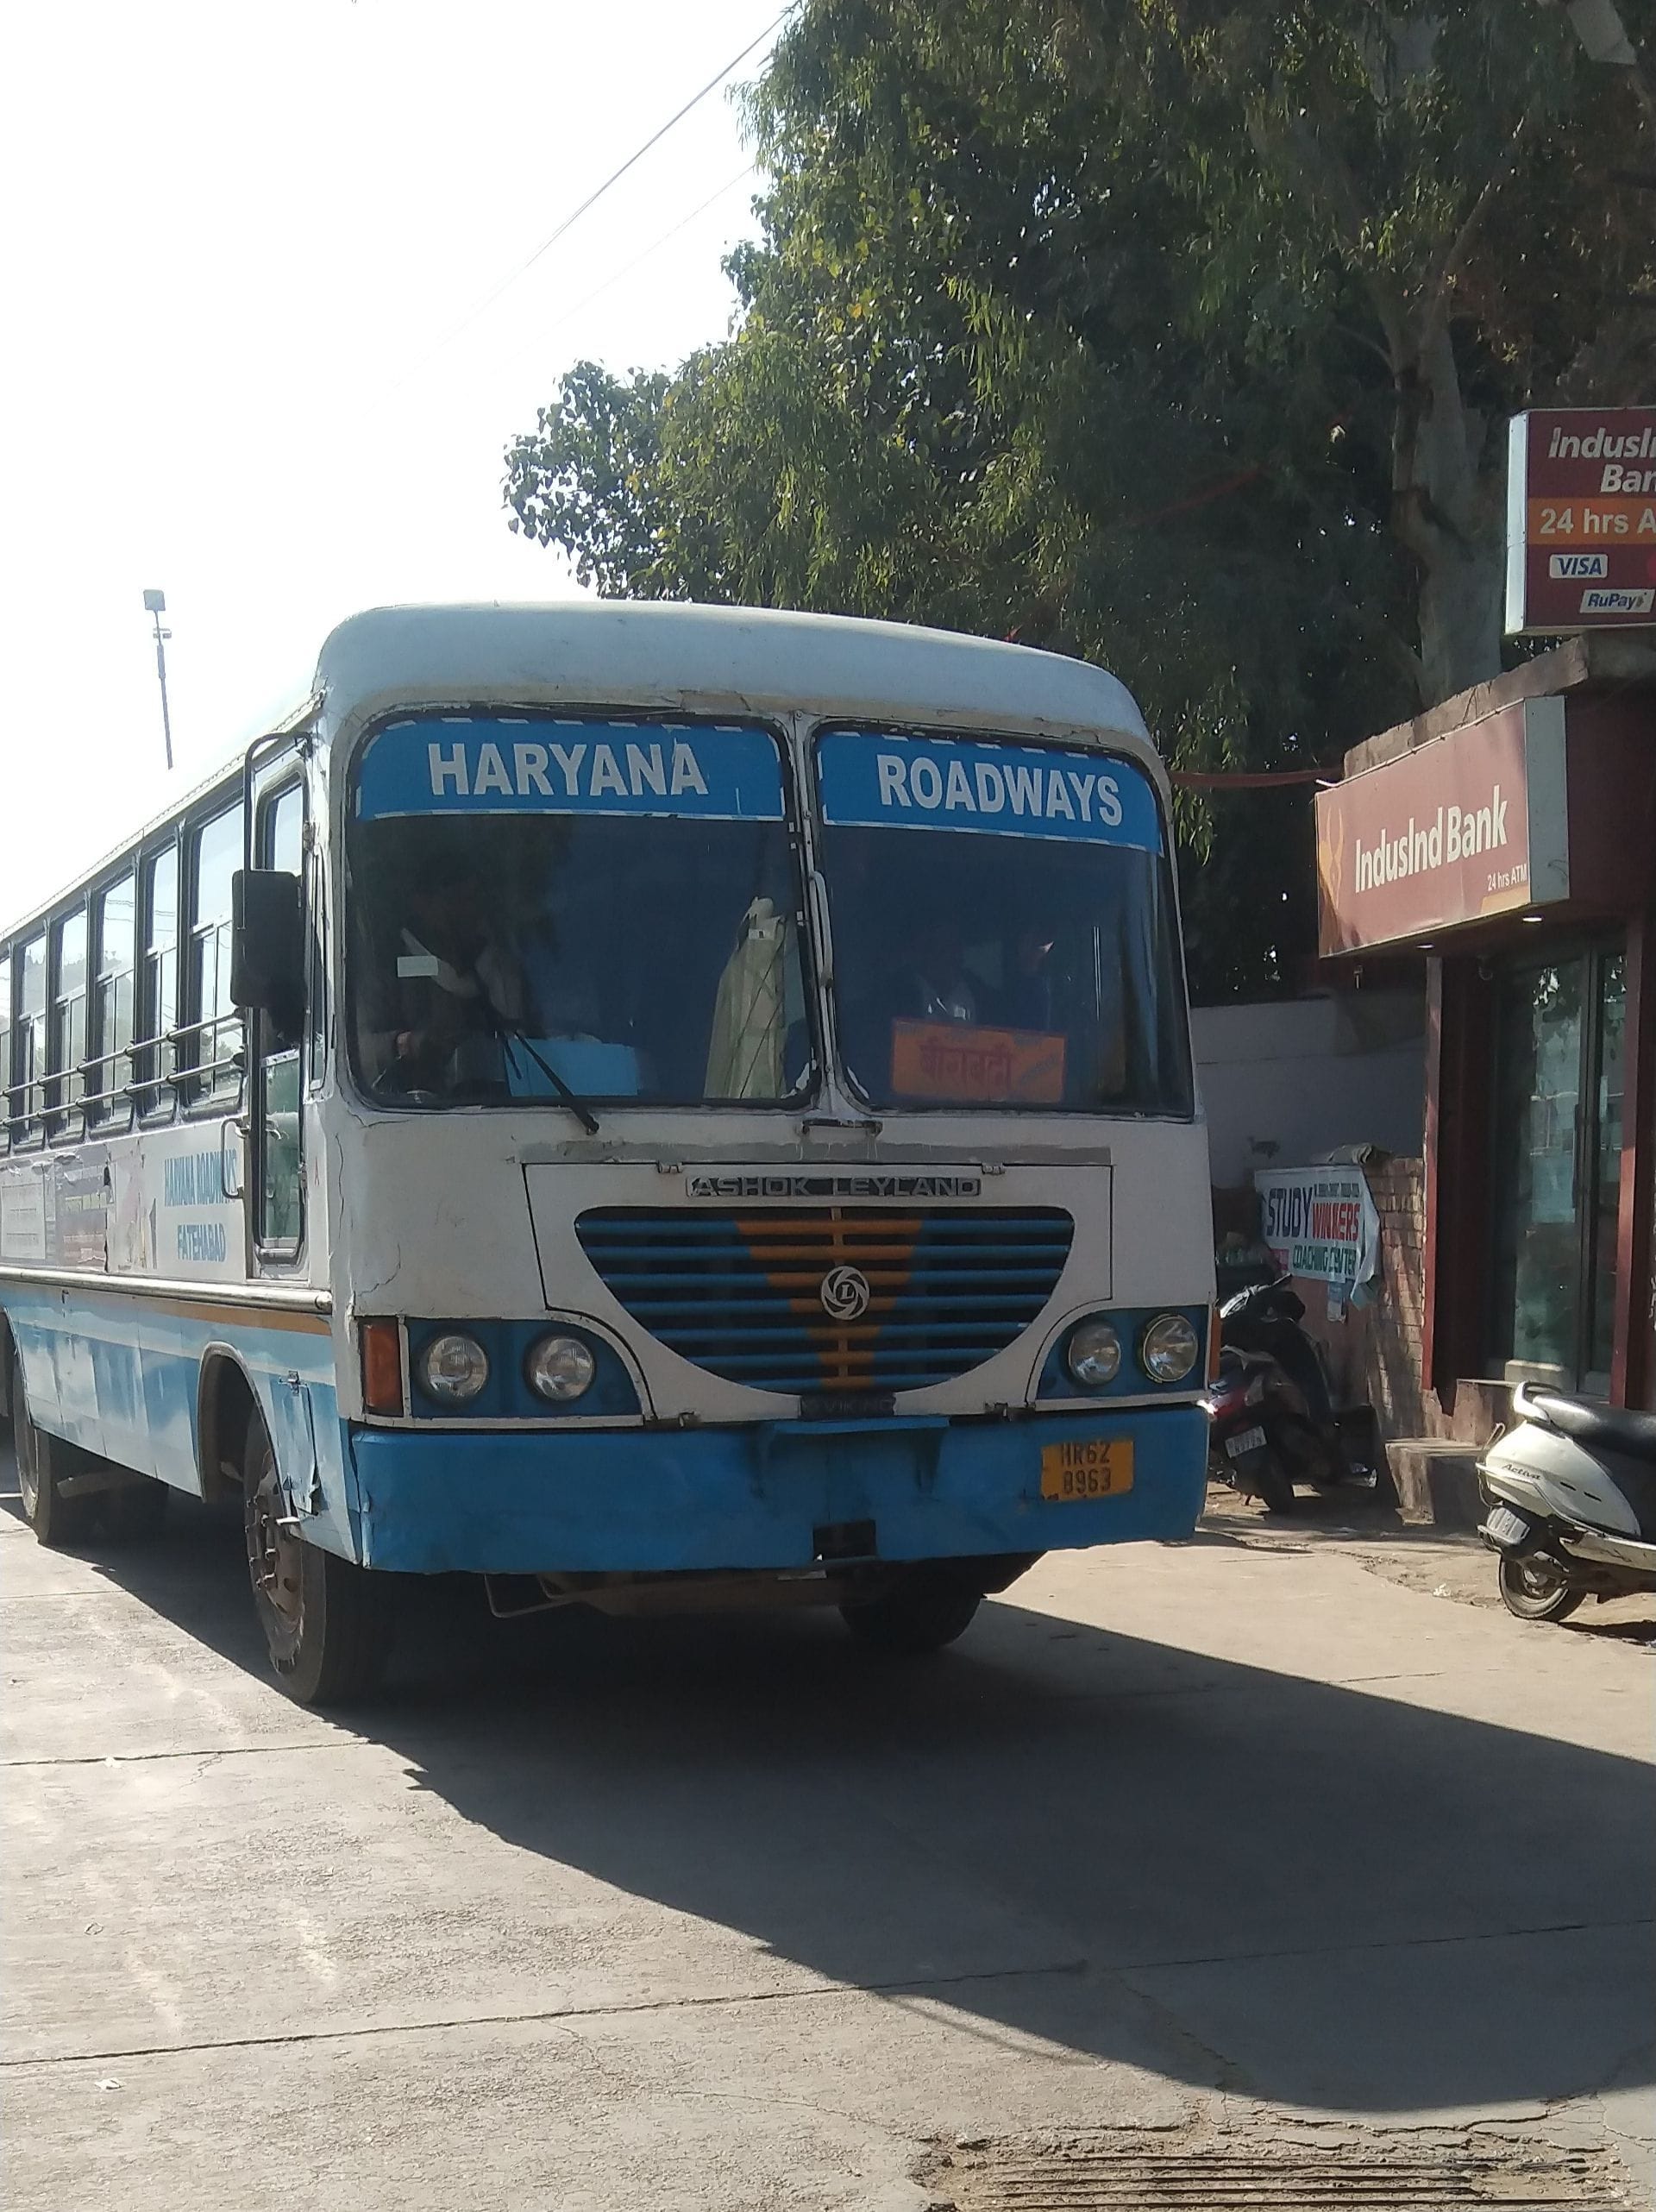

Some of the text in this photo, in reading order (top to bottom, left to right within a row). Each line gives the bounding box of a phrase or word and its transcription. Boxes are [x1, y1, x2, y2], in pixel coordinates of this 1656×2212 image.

[1540, 508, 1573, 534] 24
[1584, 508, 1628, 534] hrs
[1558, 557, 1602, 575] VISA
[1588, 593, 1635, 609] RuPay
[428, 743, 1121, 826] HARYANA ROADWAYS
[1355, 785, 1508, 893] IndusInd Bank
[1487, 864, 1527, 891] 24 hrs ATM
[690, 1177, 980, 1197] ASHOK LEYLAND
[1266, 1187, 1313, 1238] STUDY
[1502, 1464, 1541, 1480] Activa
